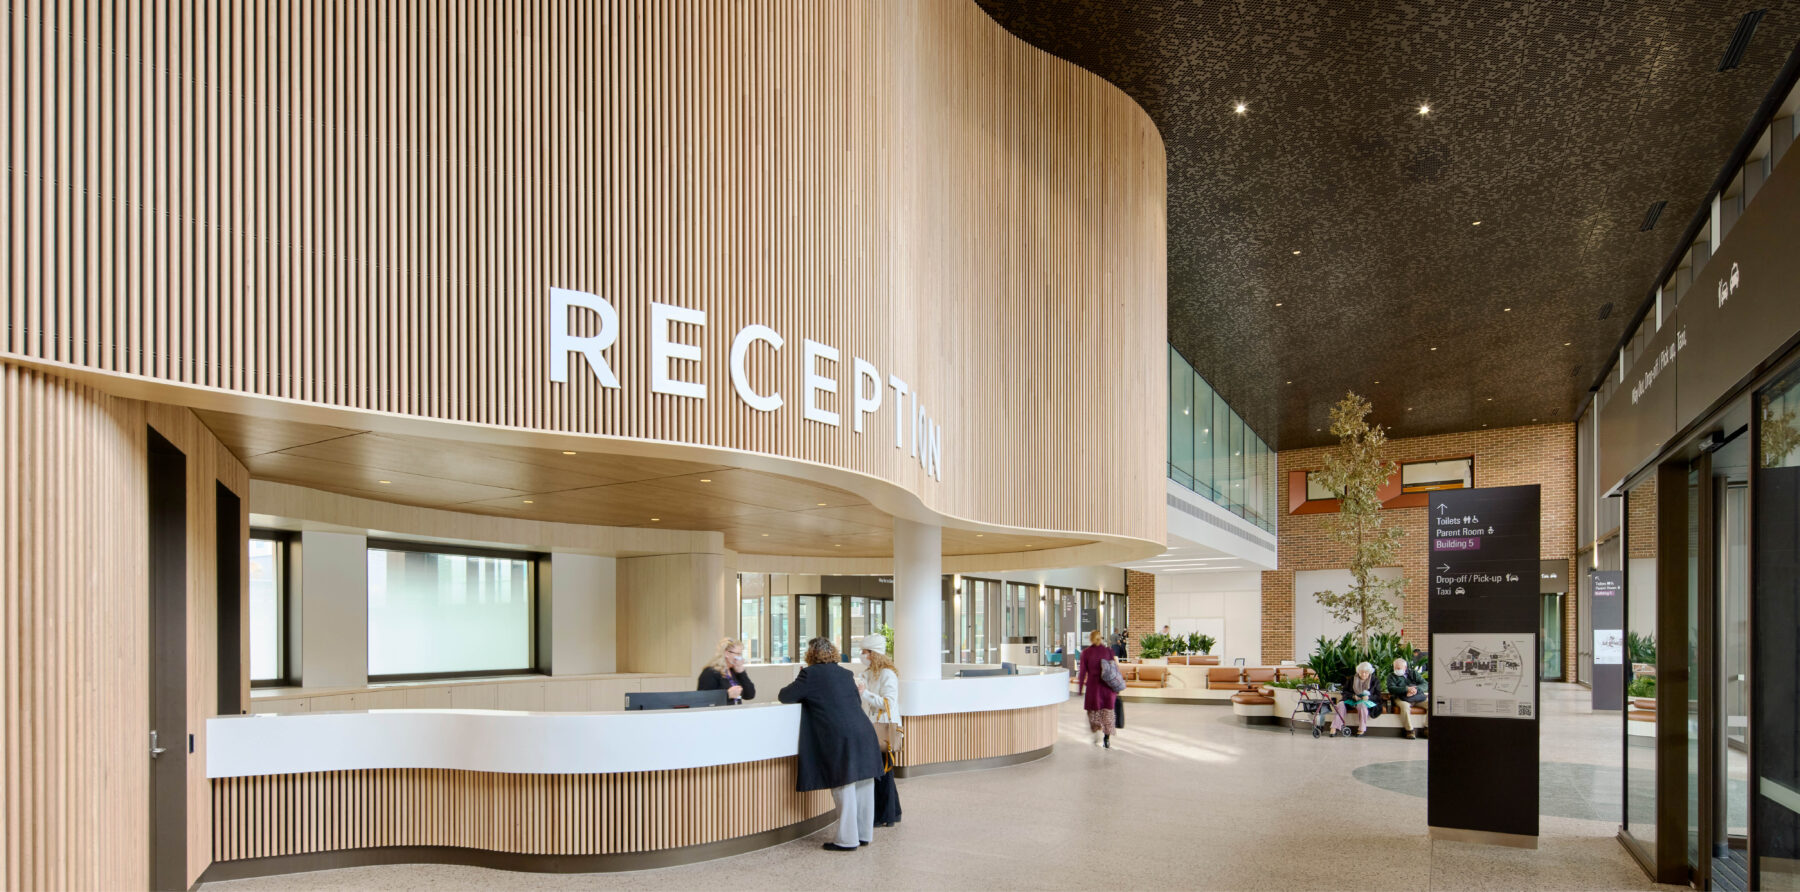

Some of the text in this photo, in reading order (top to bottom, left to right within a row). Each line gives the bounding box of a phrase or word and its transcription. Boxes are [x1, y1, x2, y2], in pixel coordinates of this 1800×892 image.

[550, 286, 942, 482] RECEPTION
[1436, 516, 1461, 526] Toilets
[1436, 527, 1484, 537] Parent Room
[1436, 539, 1474, 549] Building 5
[1436, 574, 1468, 585] Drop-off
[1473, 574, 1502, 584] Pick-up
[1436, 587, 1452, 596] Taxi
